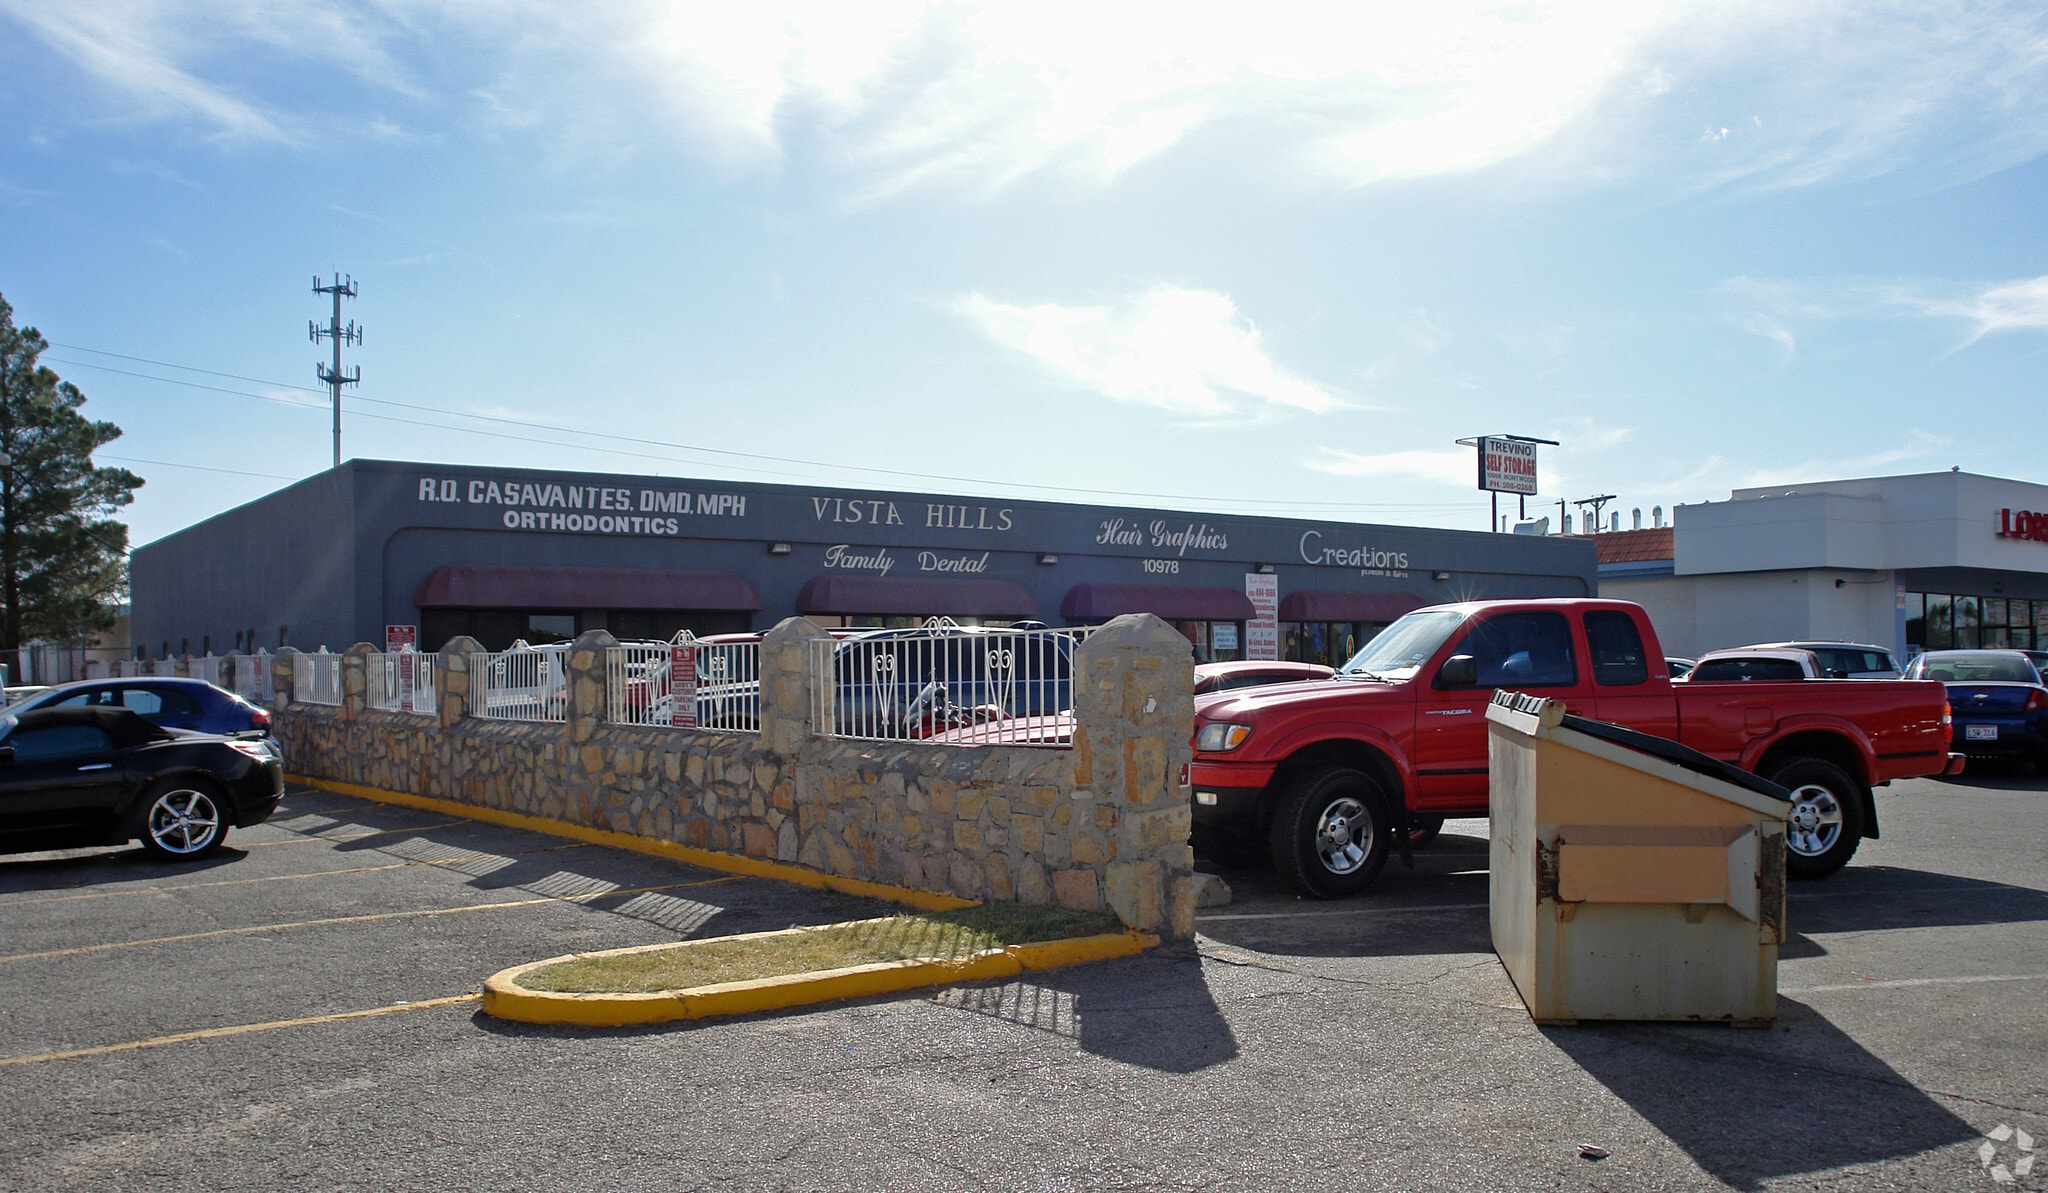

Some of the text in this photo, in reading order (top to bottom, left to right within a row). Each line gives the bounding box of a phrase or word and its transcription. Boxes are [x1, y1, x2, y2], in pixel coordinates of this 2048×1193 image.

[1490, 441, 1531, 456] TREVINO
[1486, 454, 1536, 476] SELF STORAGE
[697, 494, 746, 517] MPH
[811, 497, 1013, 531] VISTA HILLS
[503, 510, 679, 535] ORTHODONTICS
[1096, 518, 1228, 556] Hair Graphics
[1300, 530, 1408, 569] Creations
[823, 545, 990, 577] Family Dental
[1142, 559, 1179, 574] 10978
